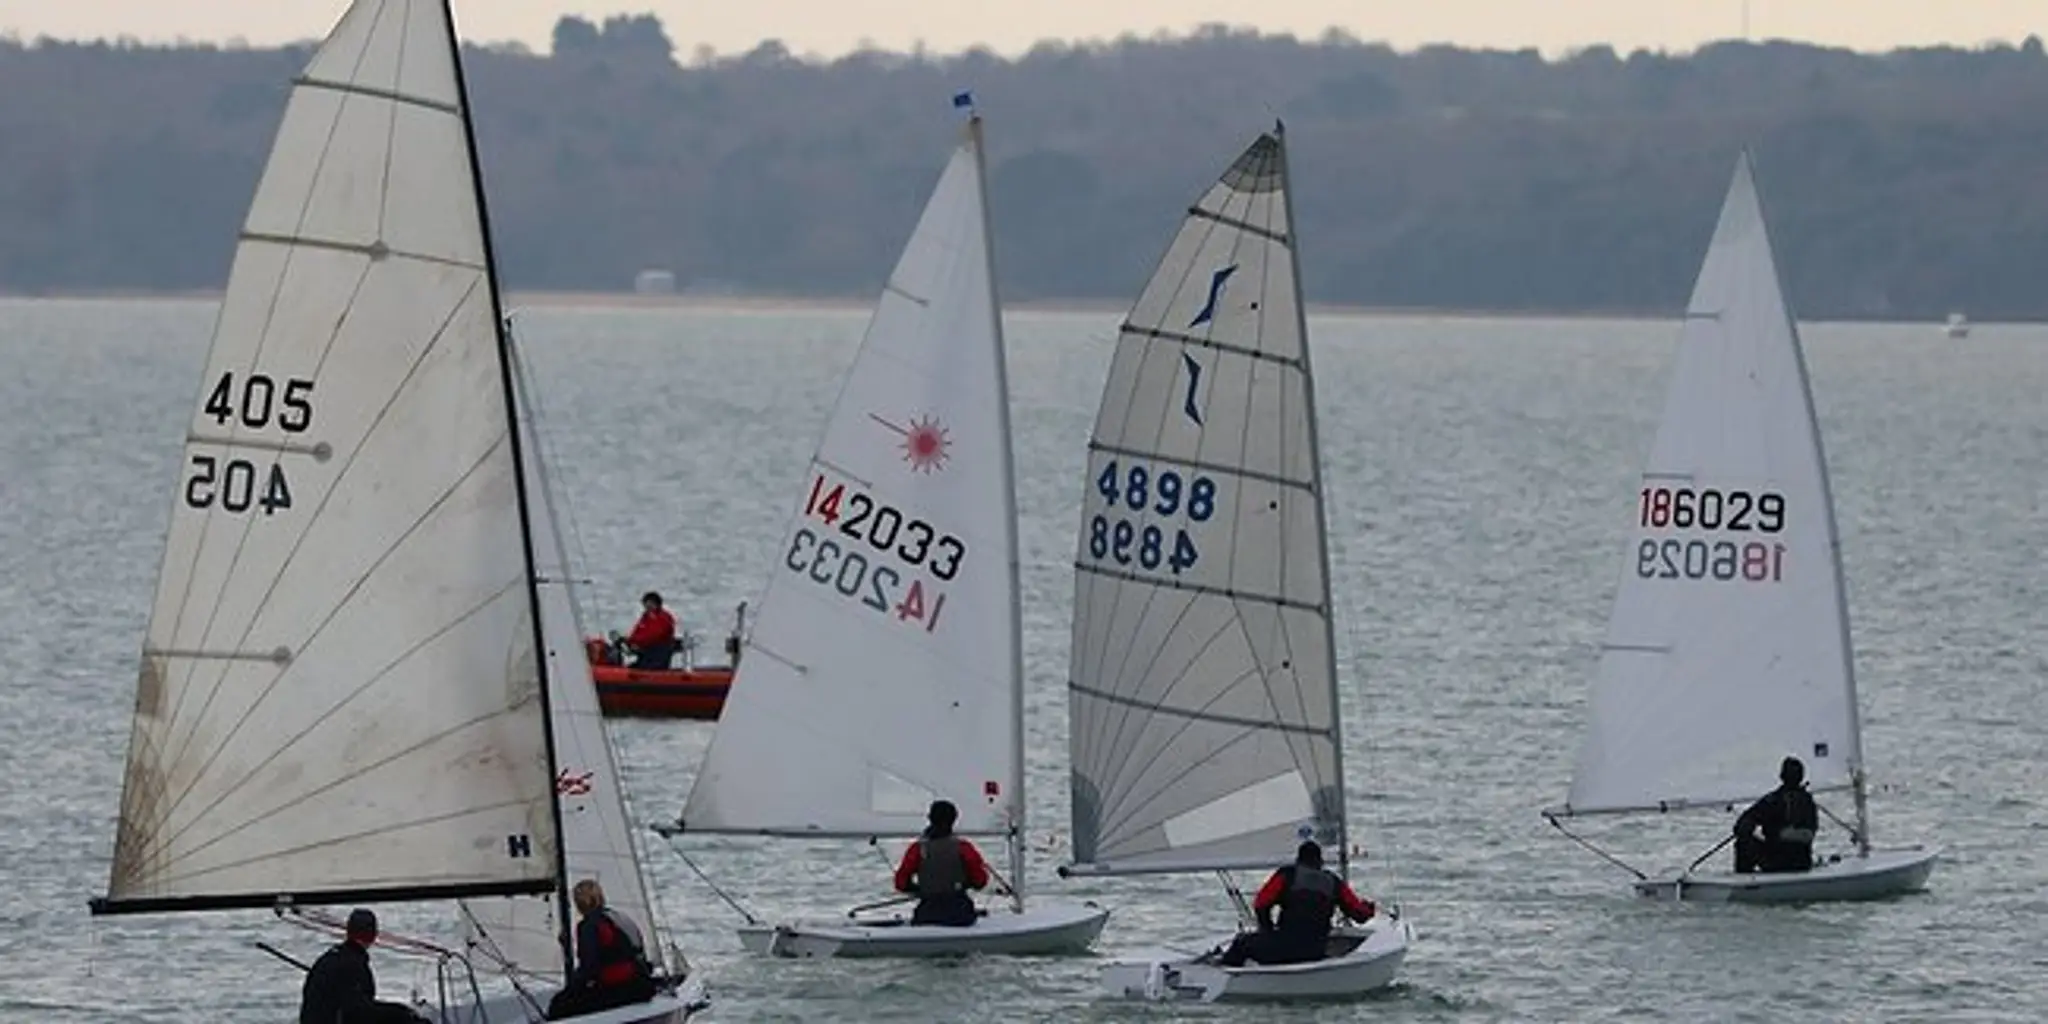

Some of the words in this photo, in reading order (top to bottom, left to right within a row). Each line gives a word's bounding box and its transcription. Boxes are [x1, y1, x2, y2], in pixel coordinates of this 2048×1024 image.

[204, 371, 314, 433] 405
[1097, 461, 1216, 522] 4898
[1641, 488, 1785, 533] 186029
[805, 475, 965, 581] 142033
